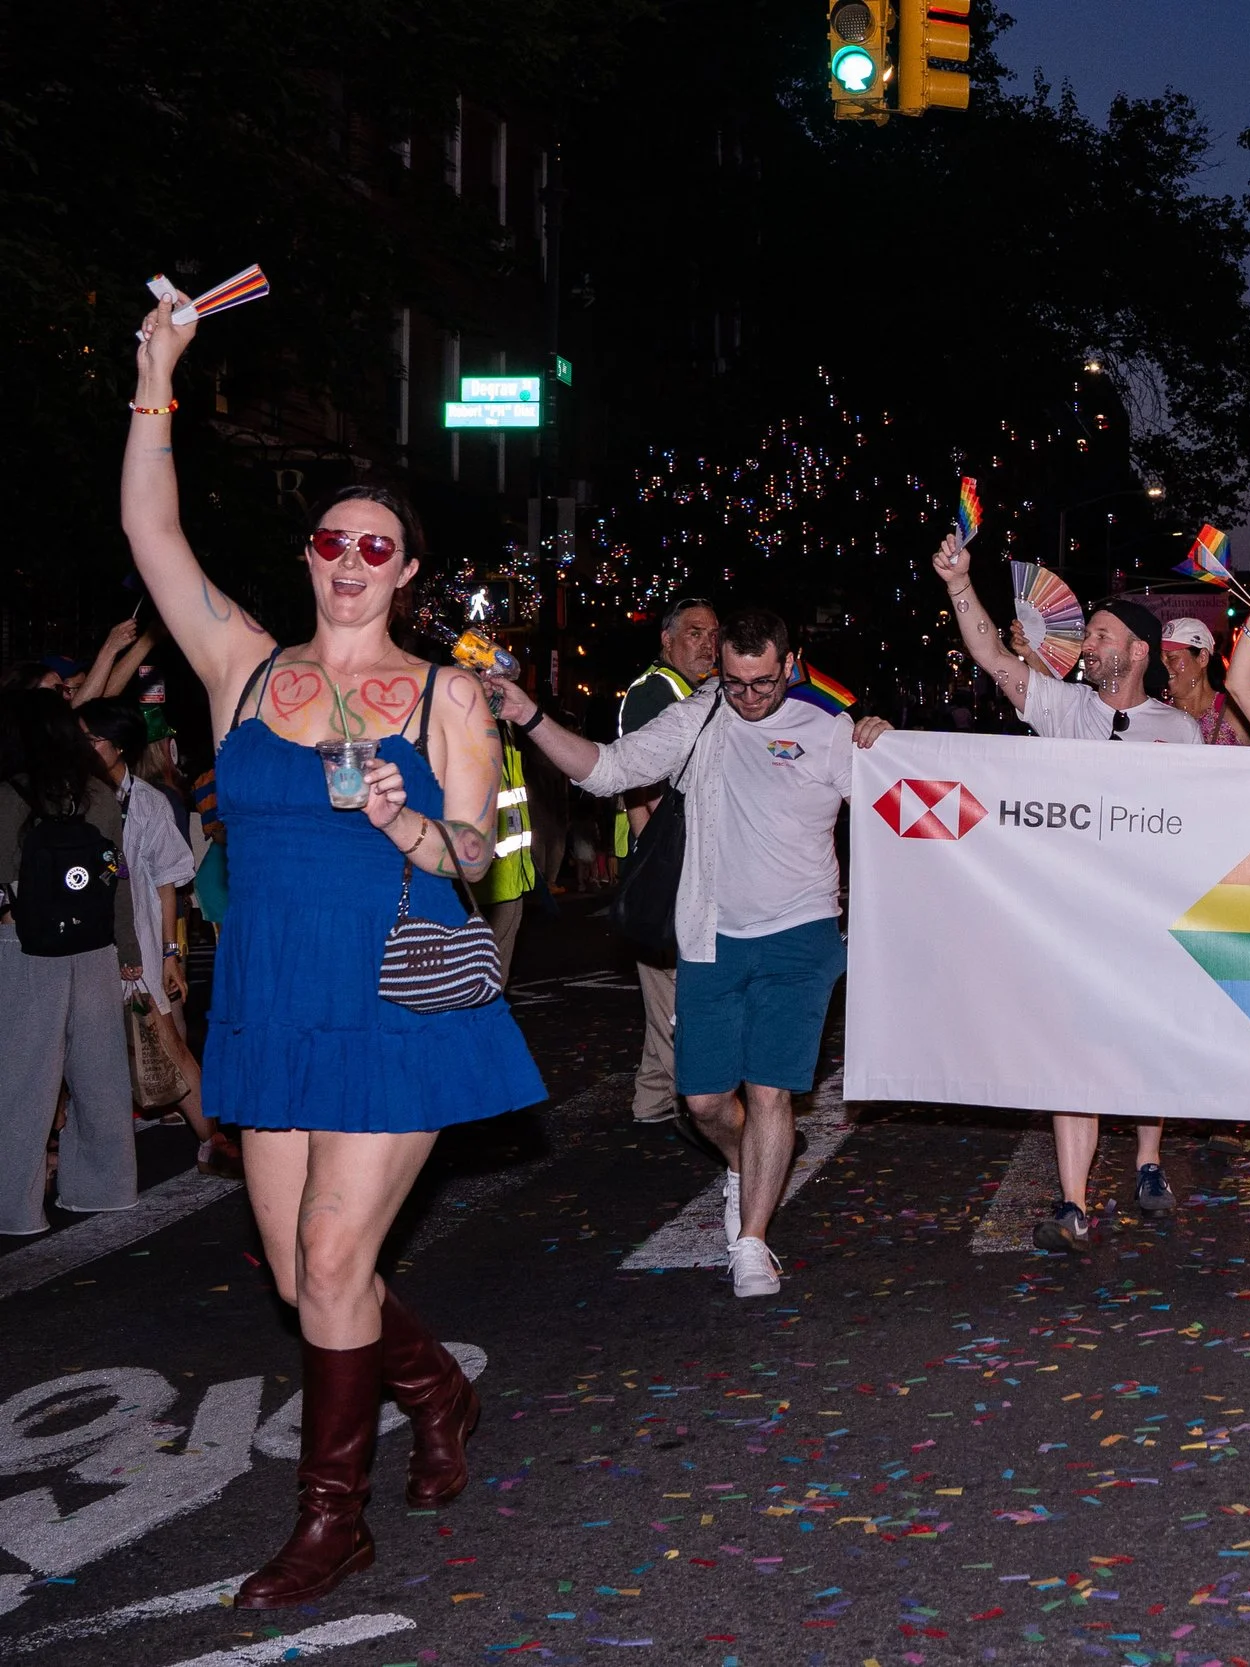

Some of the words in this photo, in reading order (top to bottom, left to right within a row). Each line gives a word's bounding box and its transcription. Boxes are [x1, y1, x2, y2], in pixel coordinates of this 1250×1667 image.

[471, 379, 518, 401] Degraw
[1160, 596, 1227, 608] Maimonides
[1000, 800, 1091, 831] HSBC
[1110, 806, 1183, 835] Pride
